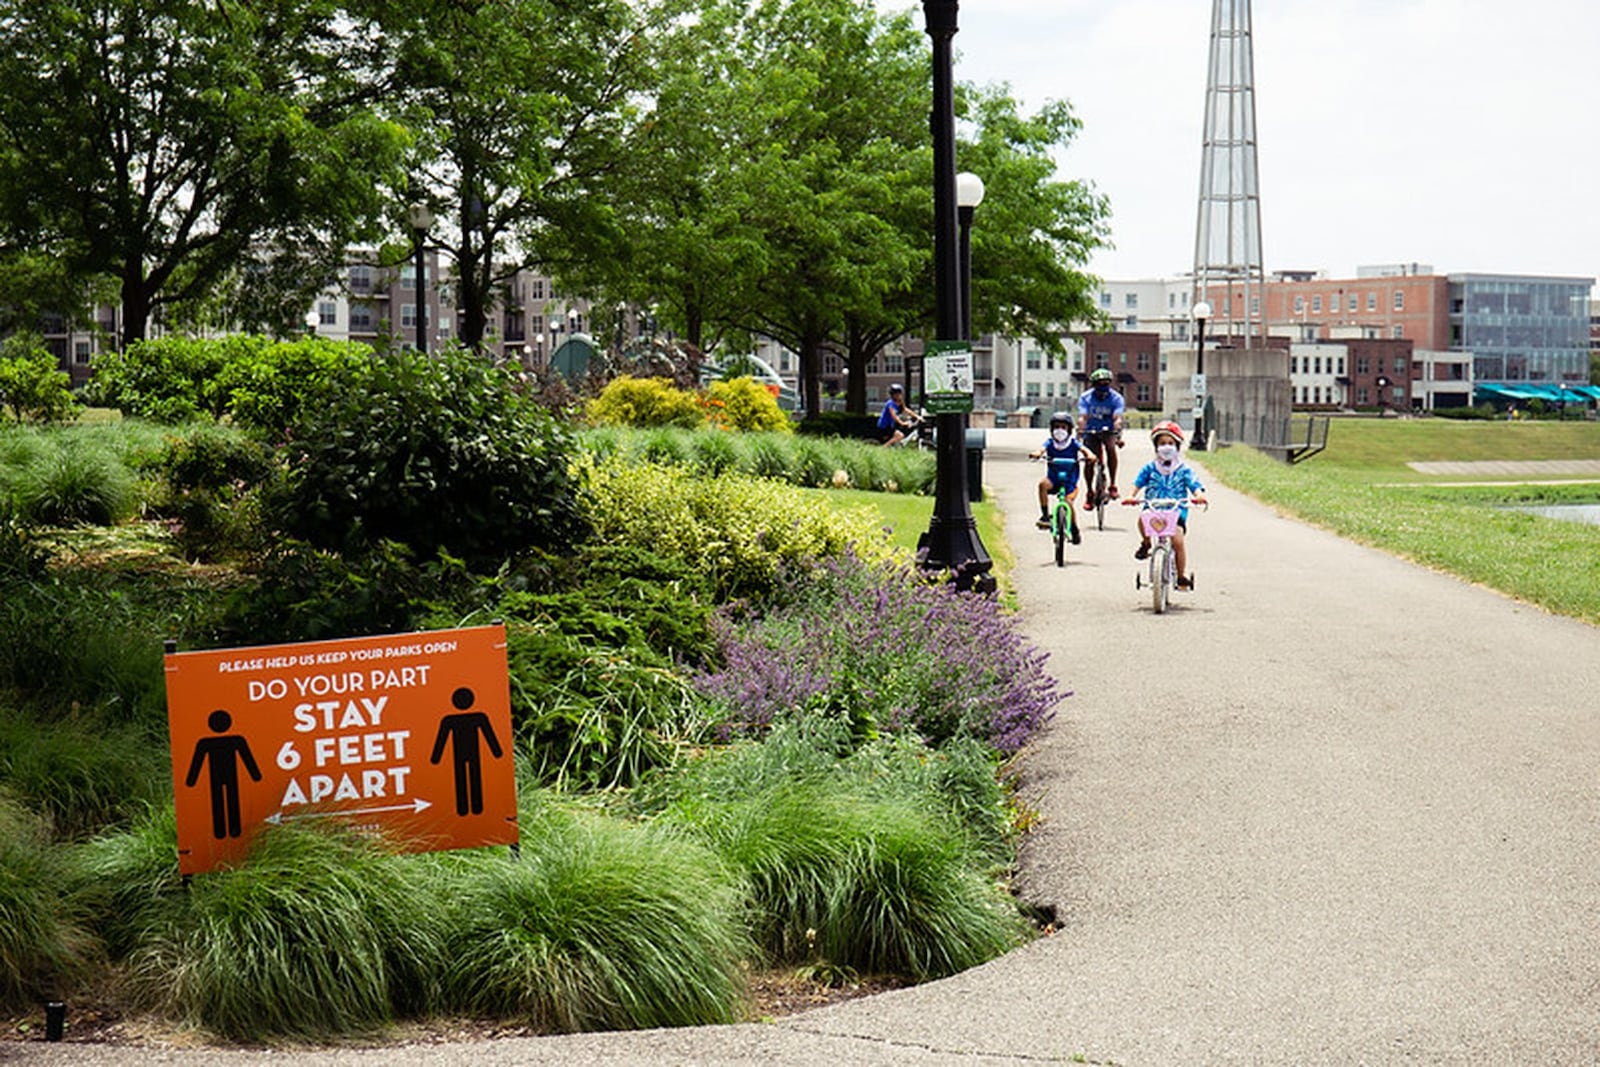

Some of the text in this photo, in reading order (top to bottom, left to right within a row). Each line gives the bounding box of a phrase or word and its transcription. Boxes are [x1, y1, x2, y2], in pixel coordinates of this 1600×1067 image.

[219, 641, 457, 673] PLEASE HELP US KEEP YOUR PARKS OPEN
[248, 665, 431, 701] DO YOUR PART
[293, 696, 388, 732] STAY
[276, 730, 411, 770] 6 FEET
[281, 766, 411, 806] APART
